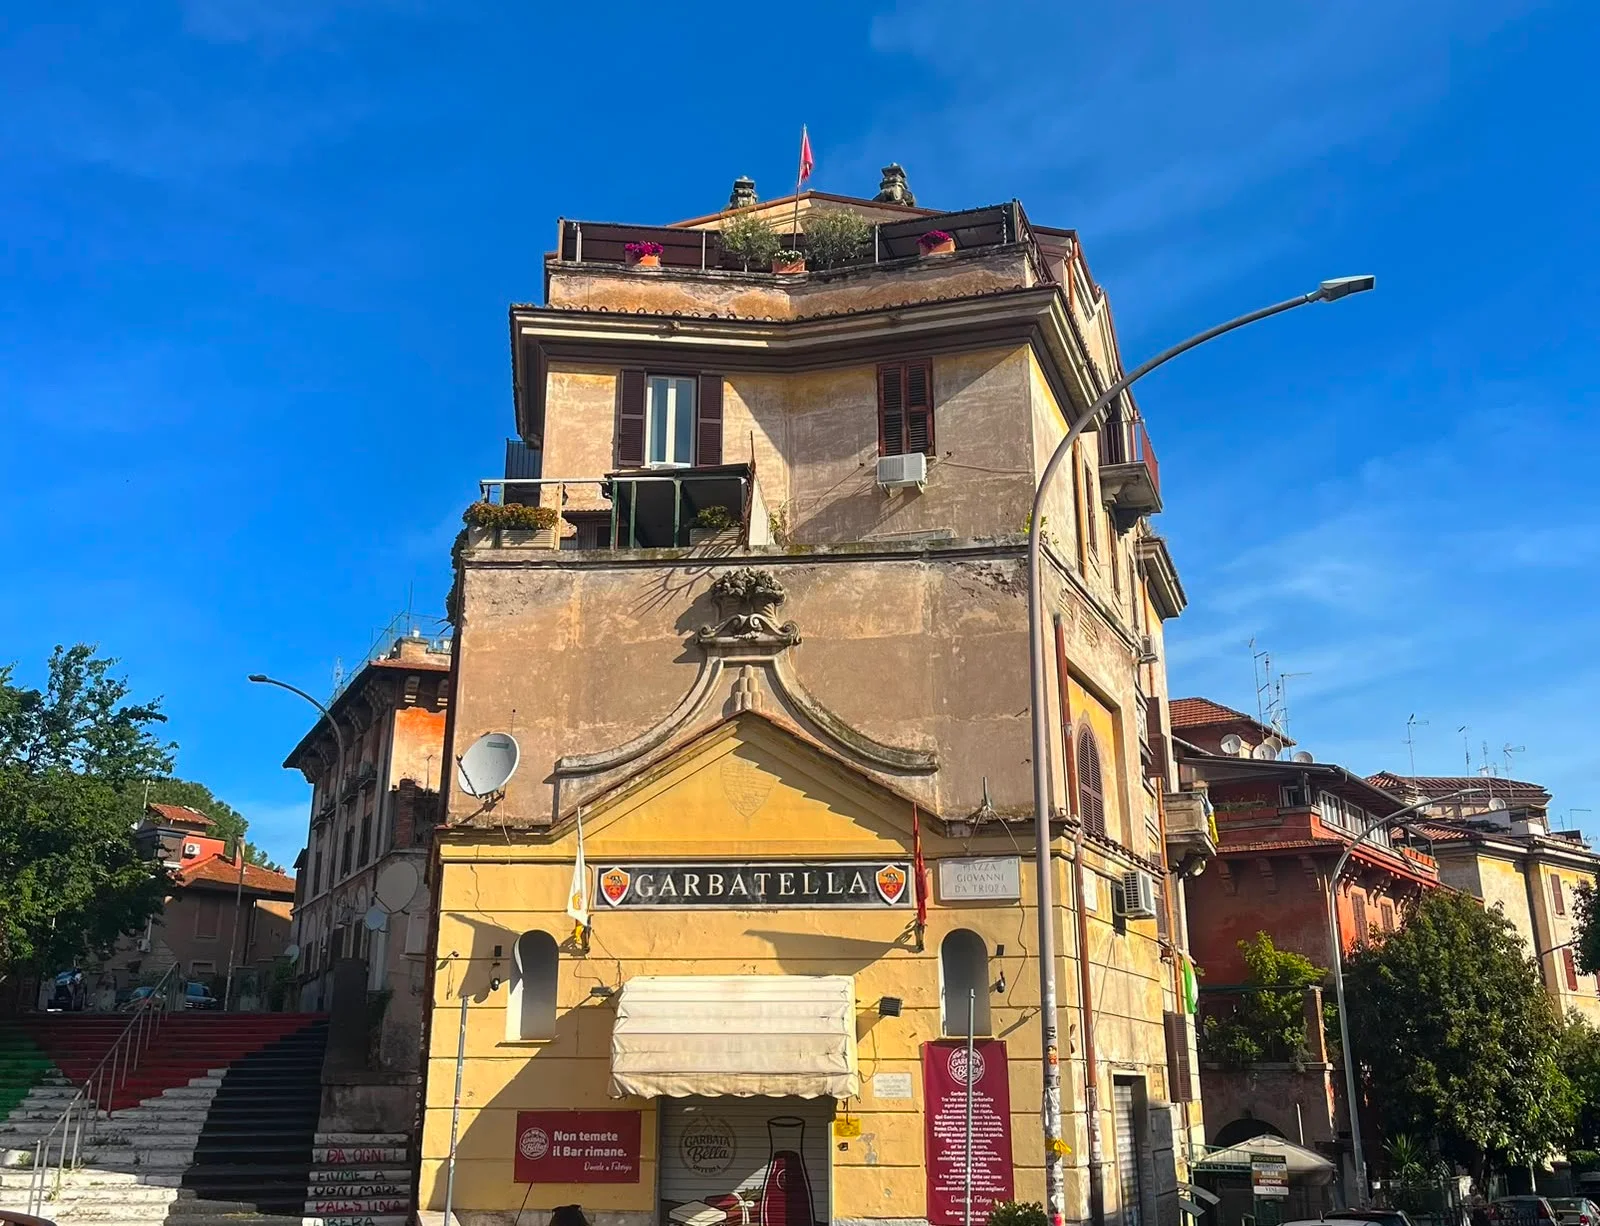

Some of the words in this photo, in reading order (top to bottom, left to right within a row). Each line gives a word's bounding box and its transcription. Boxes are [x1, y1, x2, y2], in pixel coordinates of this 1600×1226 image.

[963, 863, 996, 871] PIAZZA
[956, 873, 1004, 883] GIOVANNI
[634, 872, 869, 897] GARBATELLA
[954, 884, 967, 893] DA
[553, 1131, 577, 1141] Non
[579, 1131, 618, 1141] temete
[685, 1135, 731, 1148] GARBATA
[552, 1146, 561, 1157] il
[563, 1147, 582, 1157] Bar
[584, 1146, 627, 1157] rimane.
[687, 1146, 729, 1163] Bella
[374, 1170, 385, 1181] A
